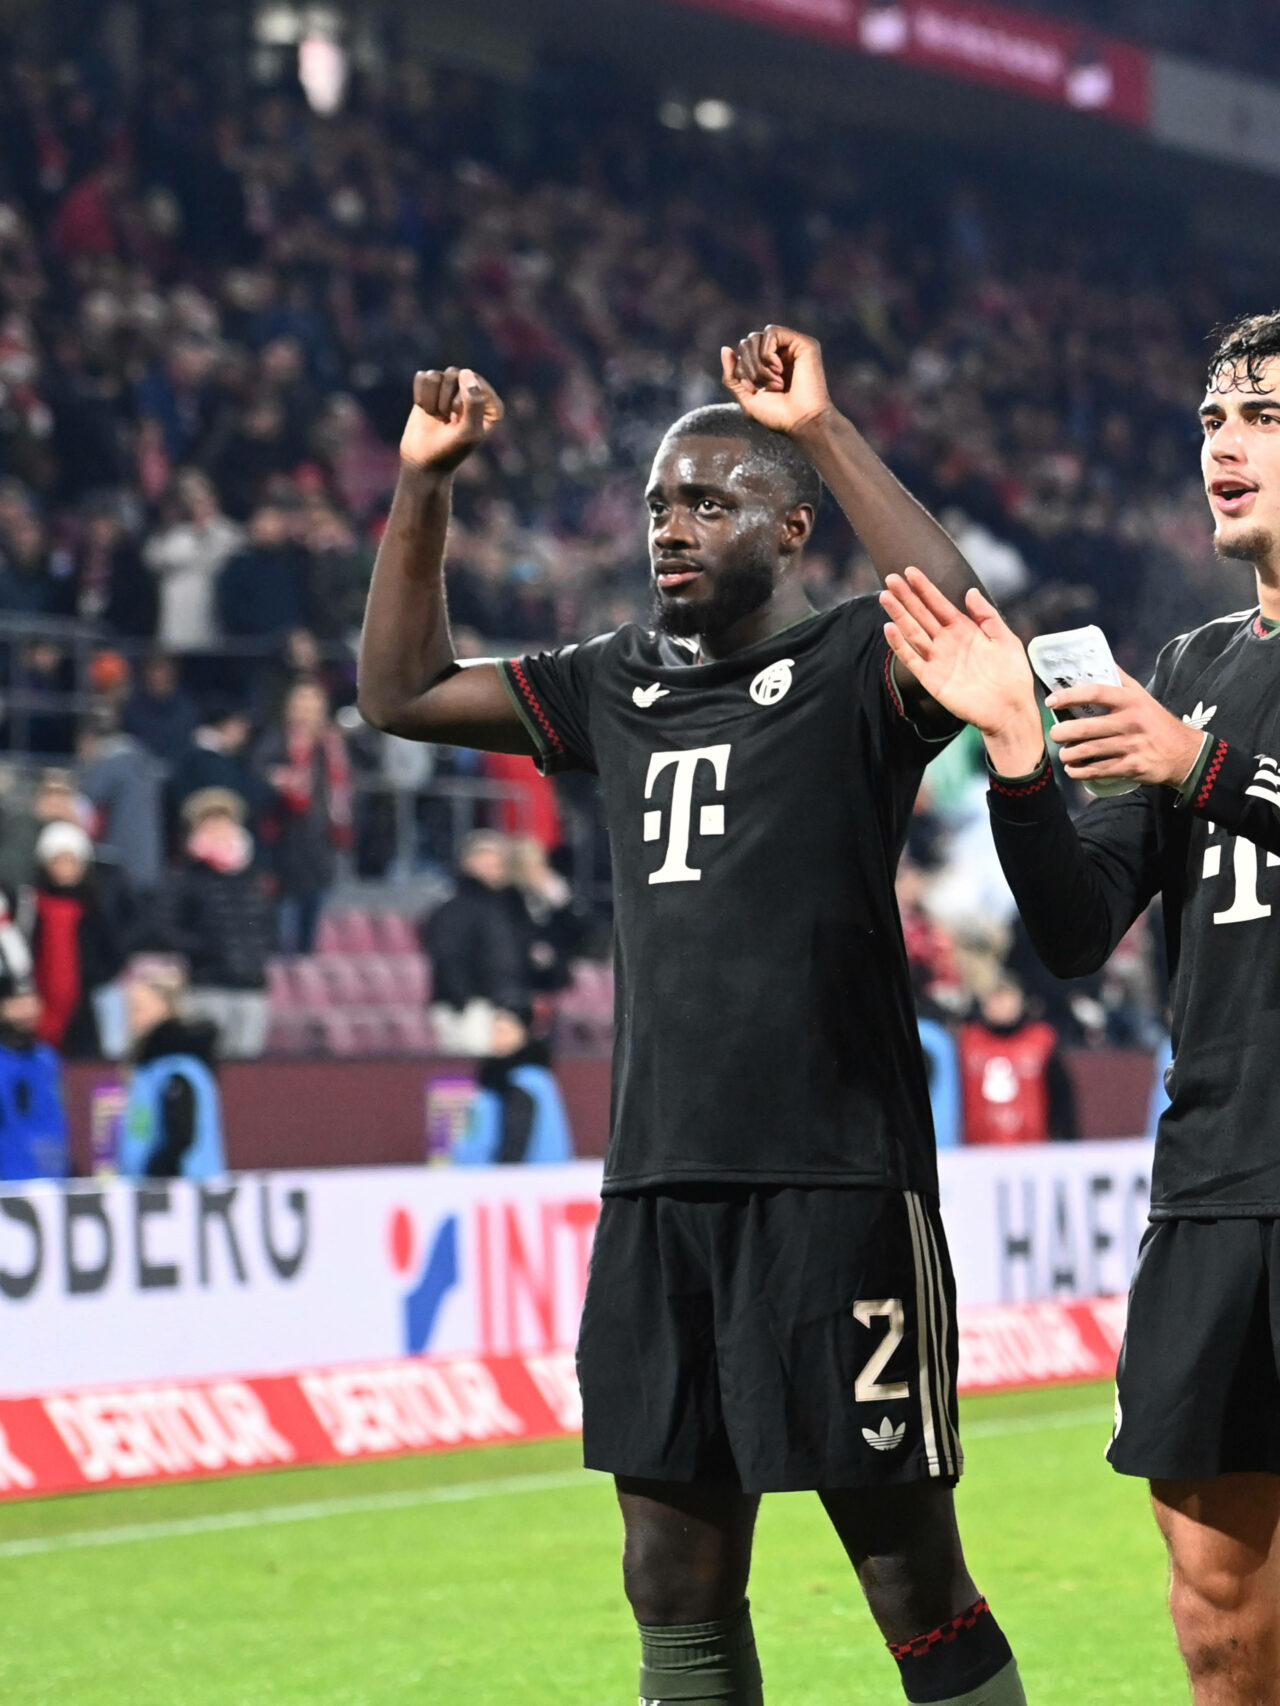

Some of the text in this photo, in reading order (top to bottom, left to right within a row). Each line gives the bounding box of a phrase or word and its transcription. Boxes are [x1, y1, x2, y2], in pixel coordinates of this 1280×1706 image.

[643, 743, 732, 885] T
[853, 1298, 910, 1402] 2
[41, 1380, 297, 1483] DERTOUR
[300, 1358, 526, 1456] DERTOUR
